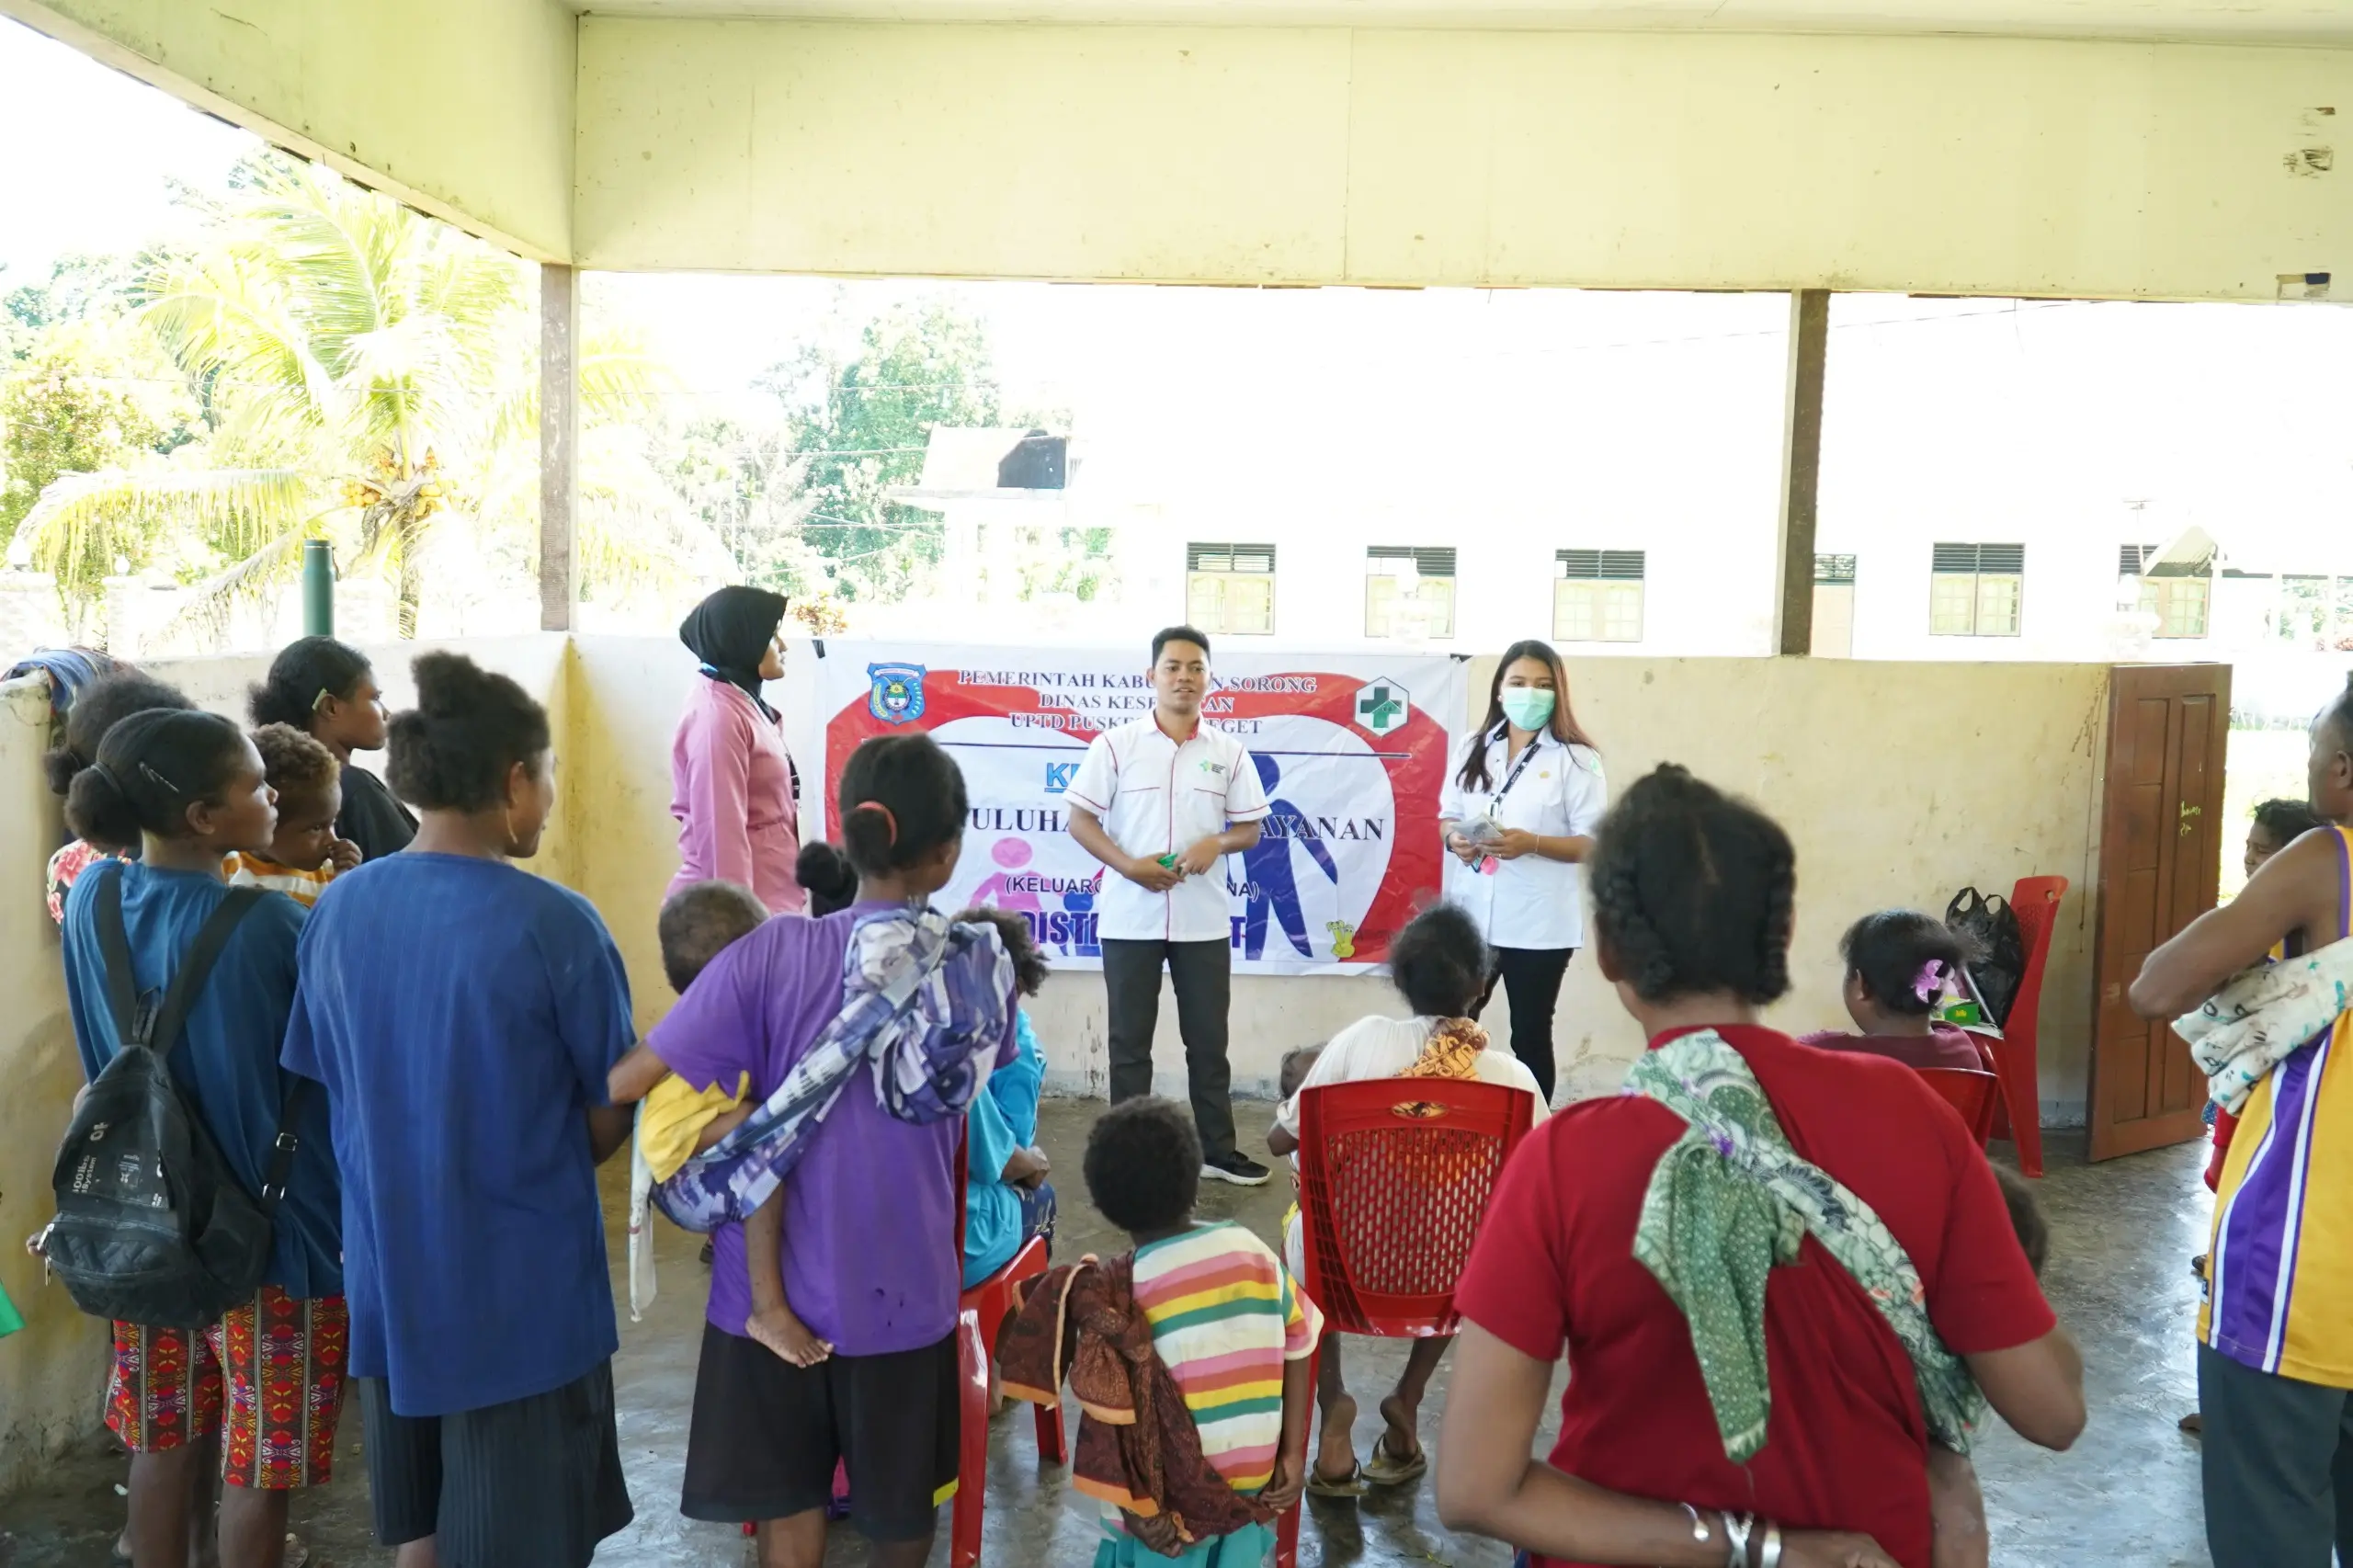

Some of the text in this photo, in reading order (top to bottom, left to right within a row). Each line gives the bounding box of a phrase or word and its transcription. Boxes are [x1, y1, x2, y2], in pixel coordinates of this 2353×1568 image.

[960, 669, 1317, 692] PEMERINTAH KABUN SORONG
[1040, 693, 1102, 709] DINAS
[1010, 712, 1064, 729] UPTD
